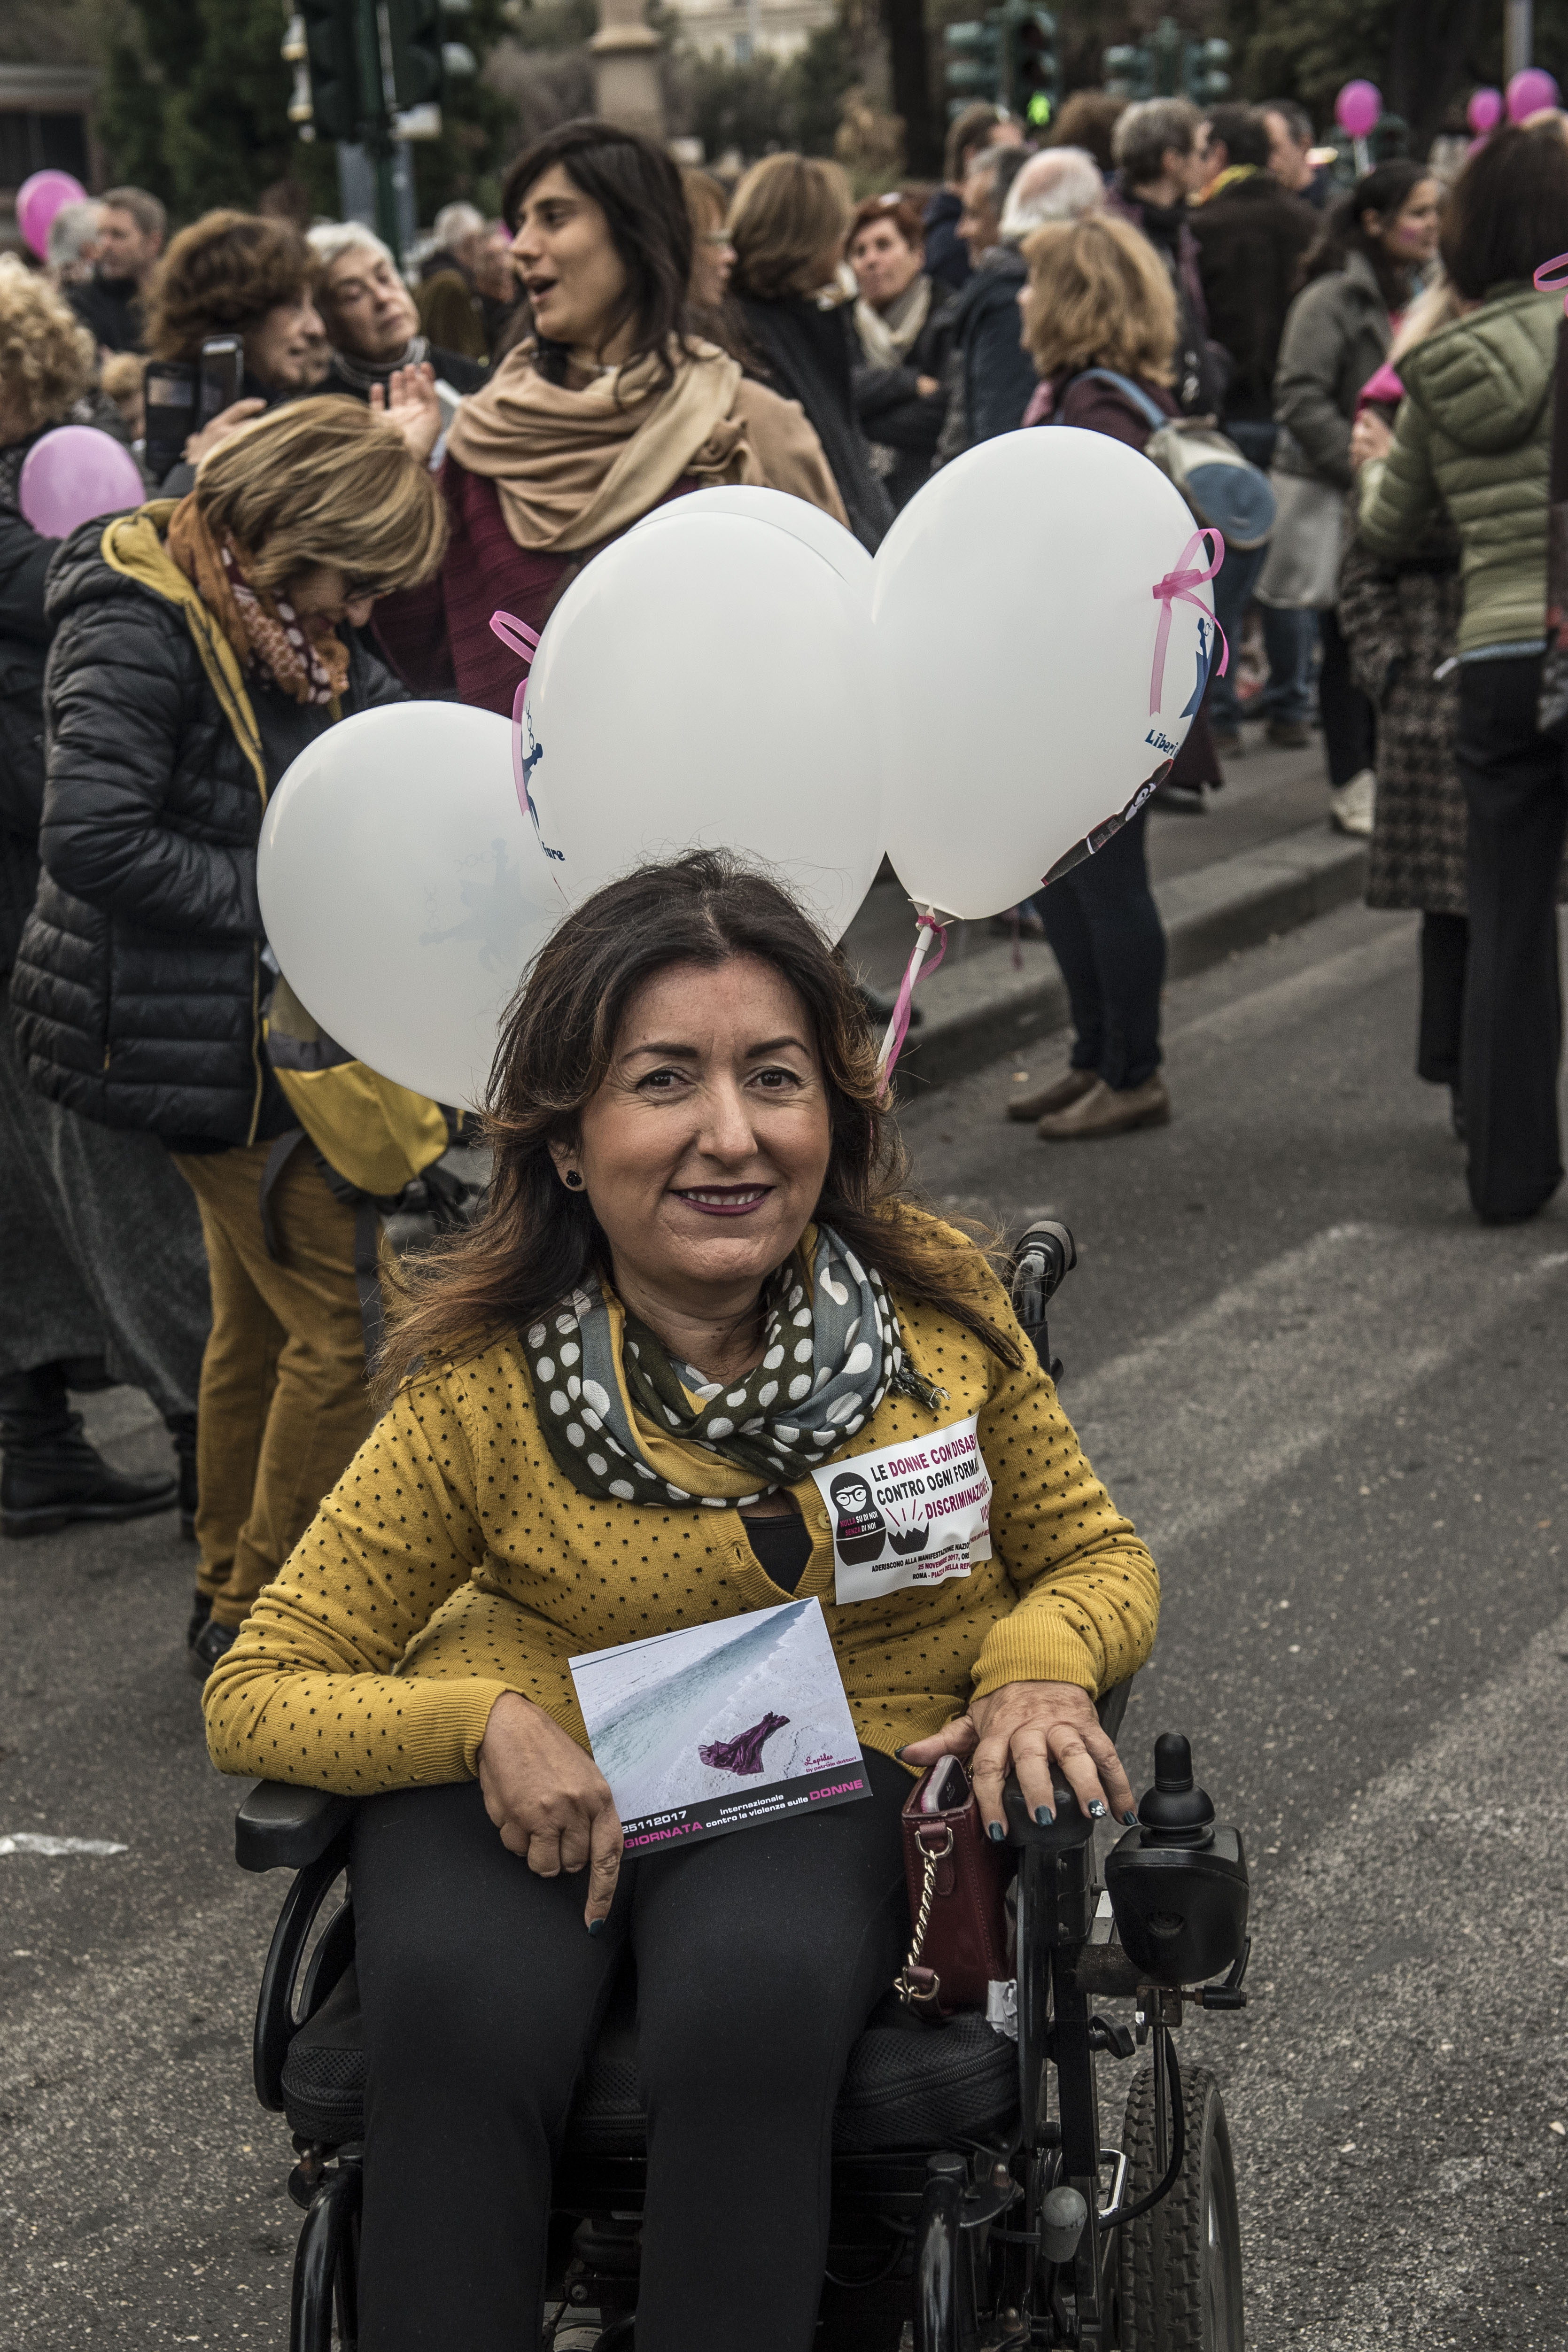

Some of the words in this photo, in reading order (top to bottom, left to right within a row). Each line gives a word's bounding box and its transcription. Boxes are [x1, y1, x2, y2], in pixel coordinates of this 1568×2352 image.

[870, 1464, 888, 1482] LE
[888, 1453, 930, 1477] DONNE
[931, 1444, 953, 1464] CON
[877, 1478, 925, 1505] CONTRO
[927, 1469, 954, 1490] OGNI
[953, 1455, 979, 1482] FORMA
[924, 1478, 987, 1520] DISCRIMINAZIONE
[840, 1517, 856, 1528] NULLA
[869, 1511, 878, 1519] NOI
[846, 1527, 861, 1536] SENZA
[867, 1522, 876, 1530] NOI
[872, 1560, 904, 1572] ADERISCONO
[905, 1557, 917, 1565] ALLA
[918, 1545, 954, 1561] MANIFESTAZIONE
[955, 1542, 970, 1550] NAZIO
[925, 1556, 947, 1569] NOVEMBRE
[945, 1563, 959, 1572] DELLA
[814, 1762, 835, 1771] patrizia
[836, 1756, 856, 1764] dottori
[624, 1821, 703, 1848] GIORNATA
[706, 1815, 737, 1828] contro
[749, 1803, 785, 1816] violenza
[787, 1797, 808, 1807] sulle
[809, 1779, 863, 1801] DONNE
[720, 1794, 784, 1815] internazionale
[622, 1810, 687, 1834] 25112017
